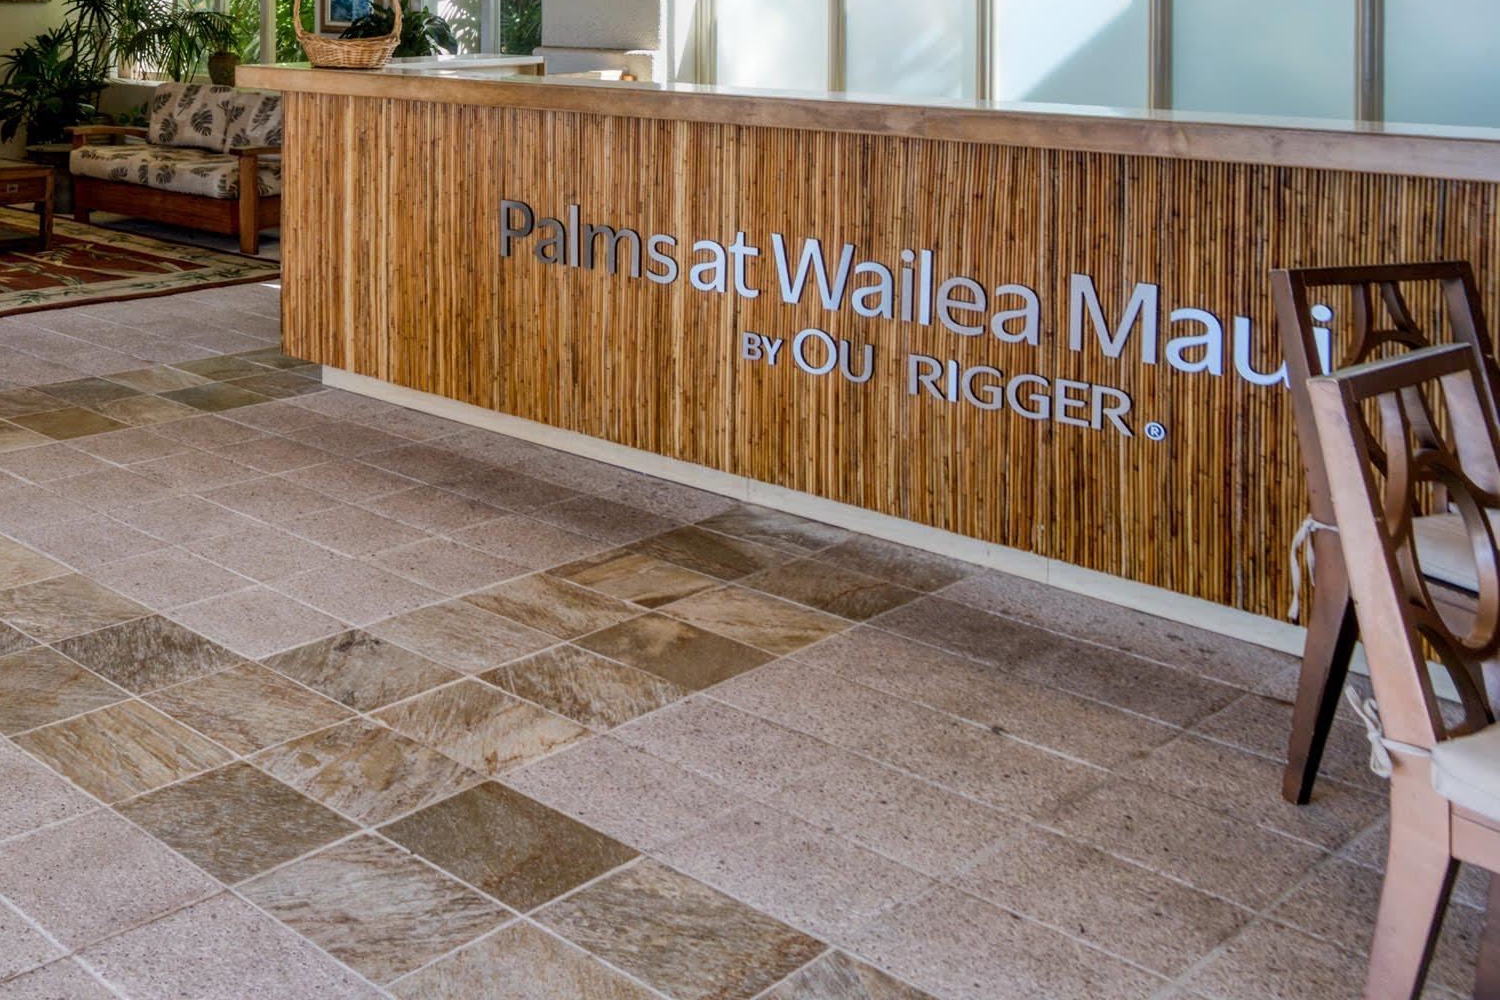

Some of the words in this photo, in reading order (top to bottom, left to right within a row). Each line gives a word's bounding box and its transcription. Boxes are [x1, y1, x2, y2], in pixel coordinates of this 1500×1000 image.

[500, 199, 680, 285] Palms
[689, 231, 761, 299] at
[771, 232, 1041, 347] Wailea
[1069, 272, 1333, 390] Maui
[742, 331, 783, 366] BY
